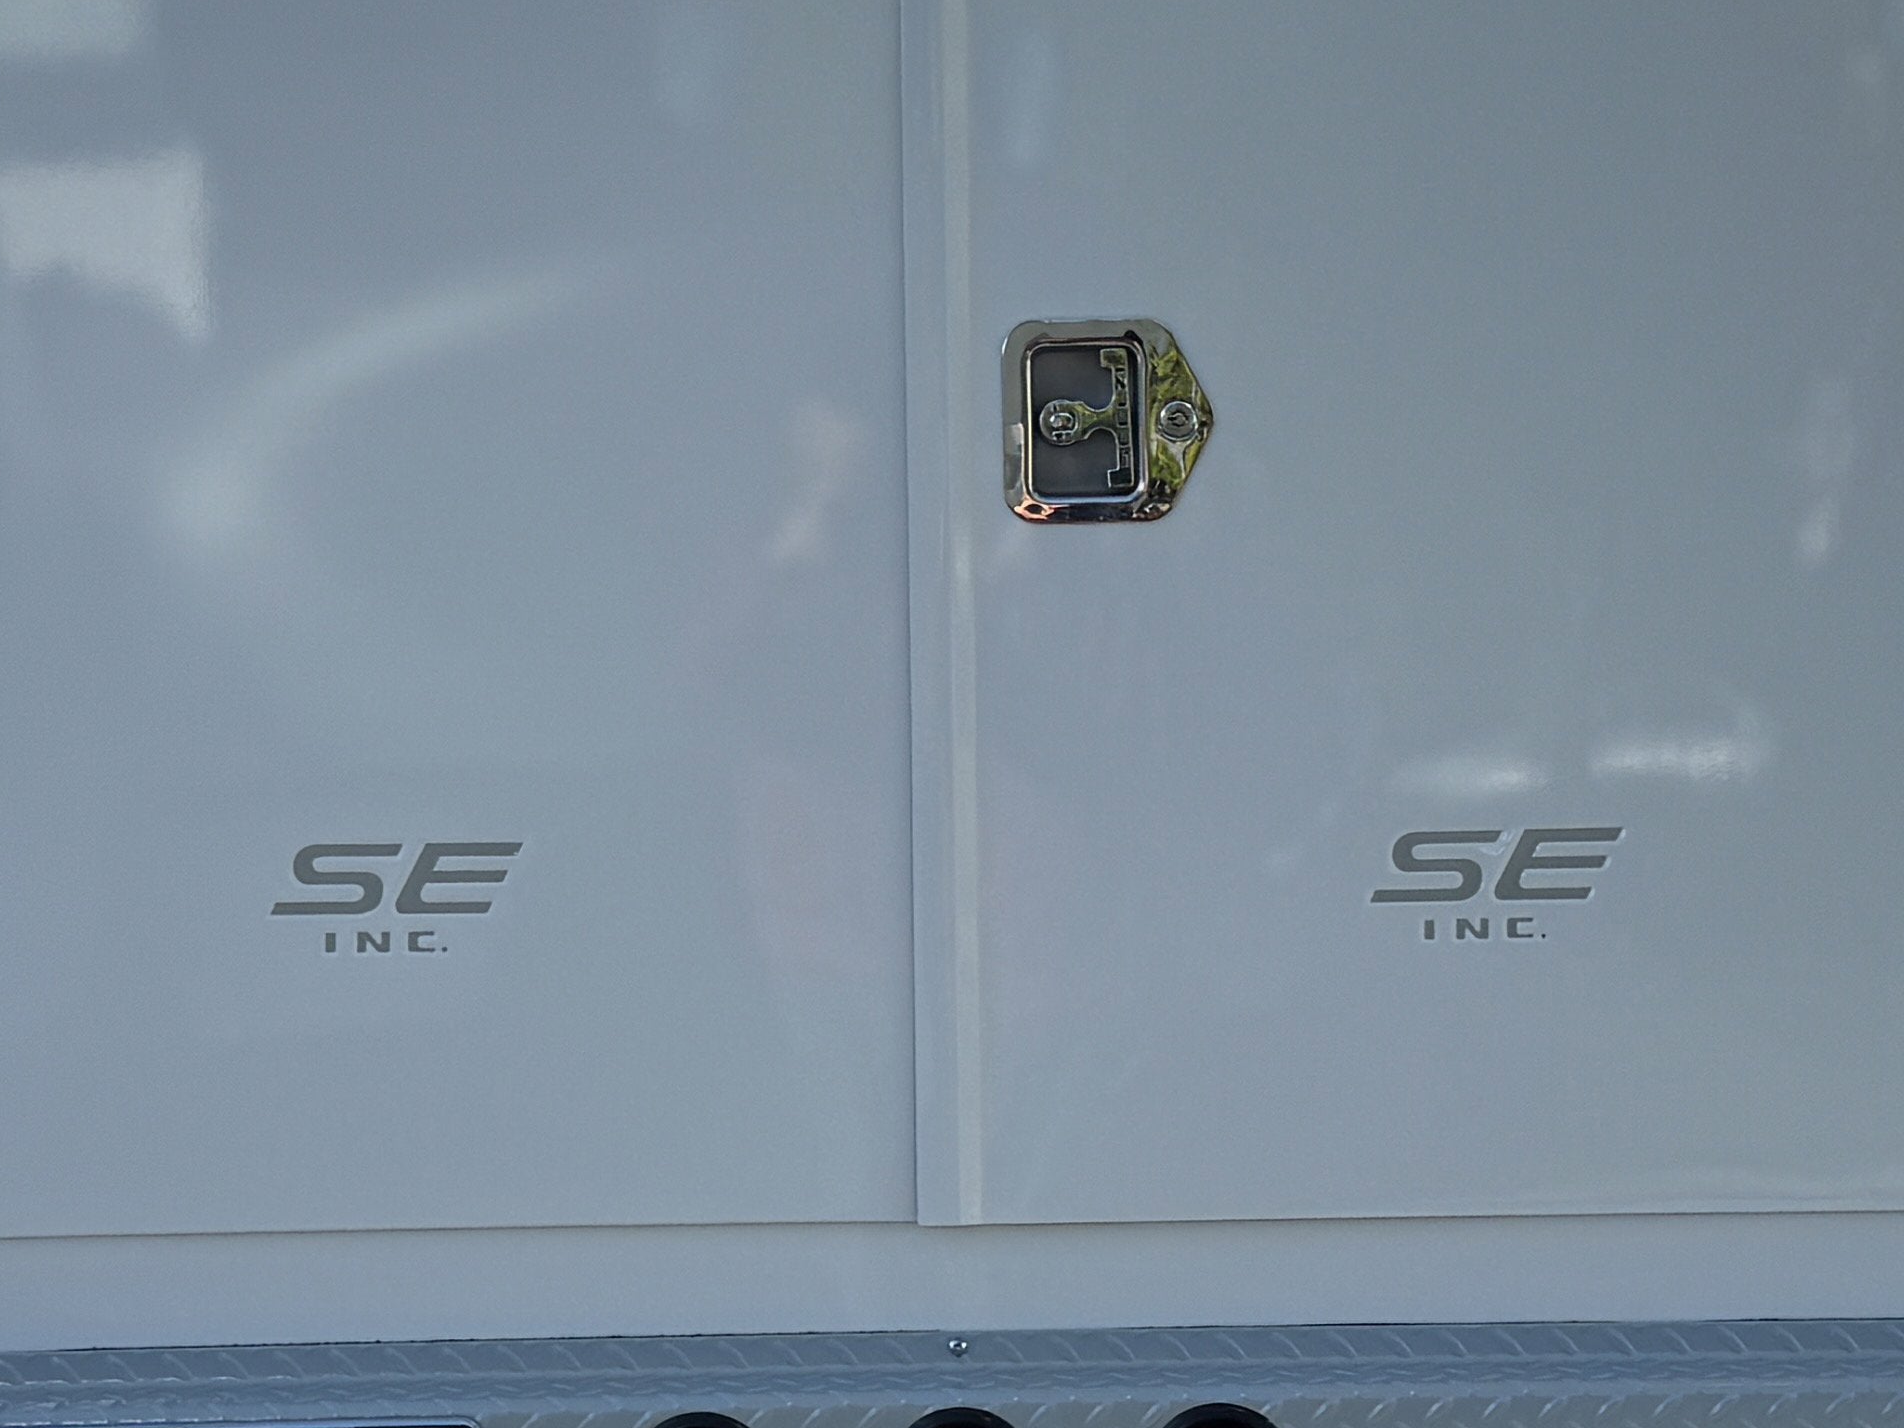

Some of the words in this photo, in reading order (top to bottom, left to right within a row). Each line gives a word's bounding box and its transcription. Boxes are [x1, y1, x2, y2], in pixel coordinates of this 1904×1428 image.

[270, 842, 524, 915] SE
[1370, 826, 1624, 903] SE
[324, 931, 448, 953] INC.
[1423, 917, 1547, 940] INC.
